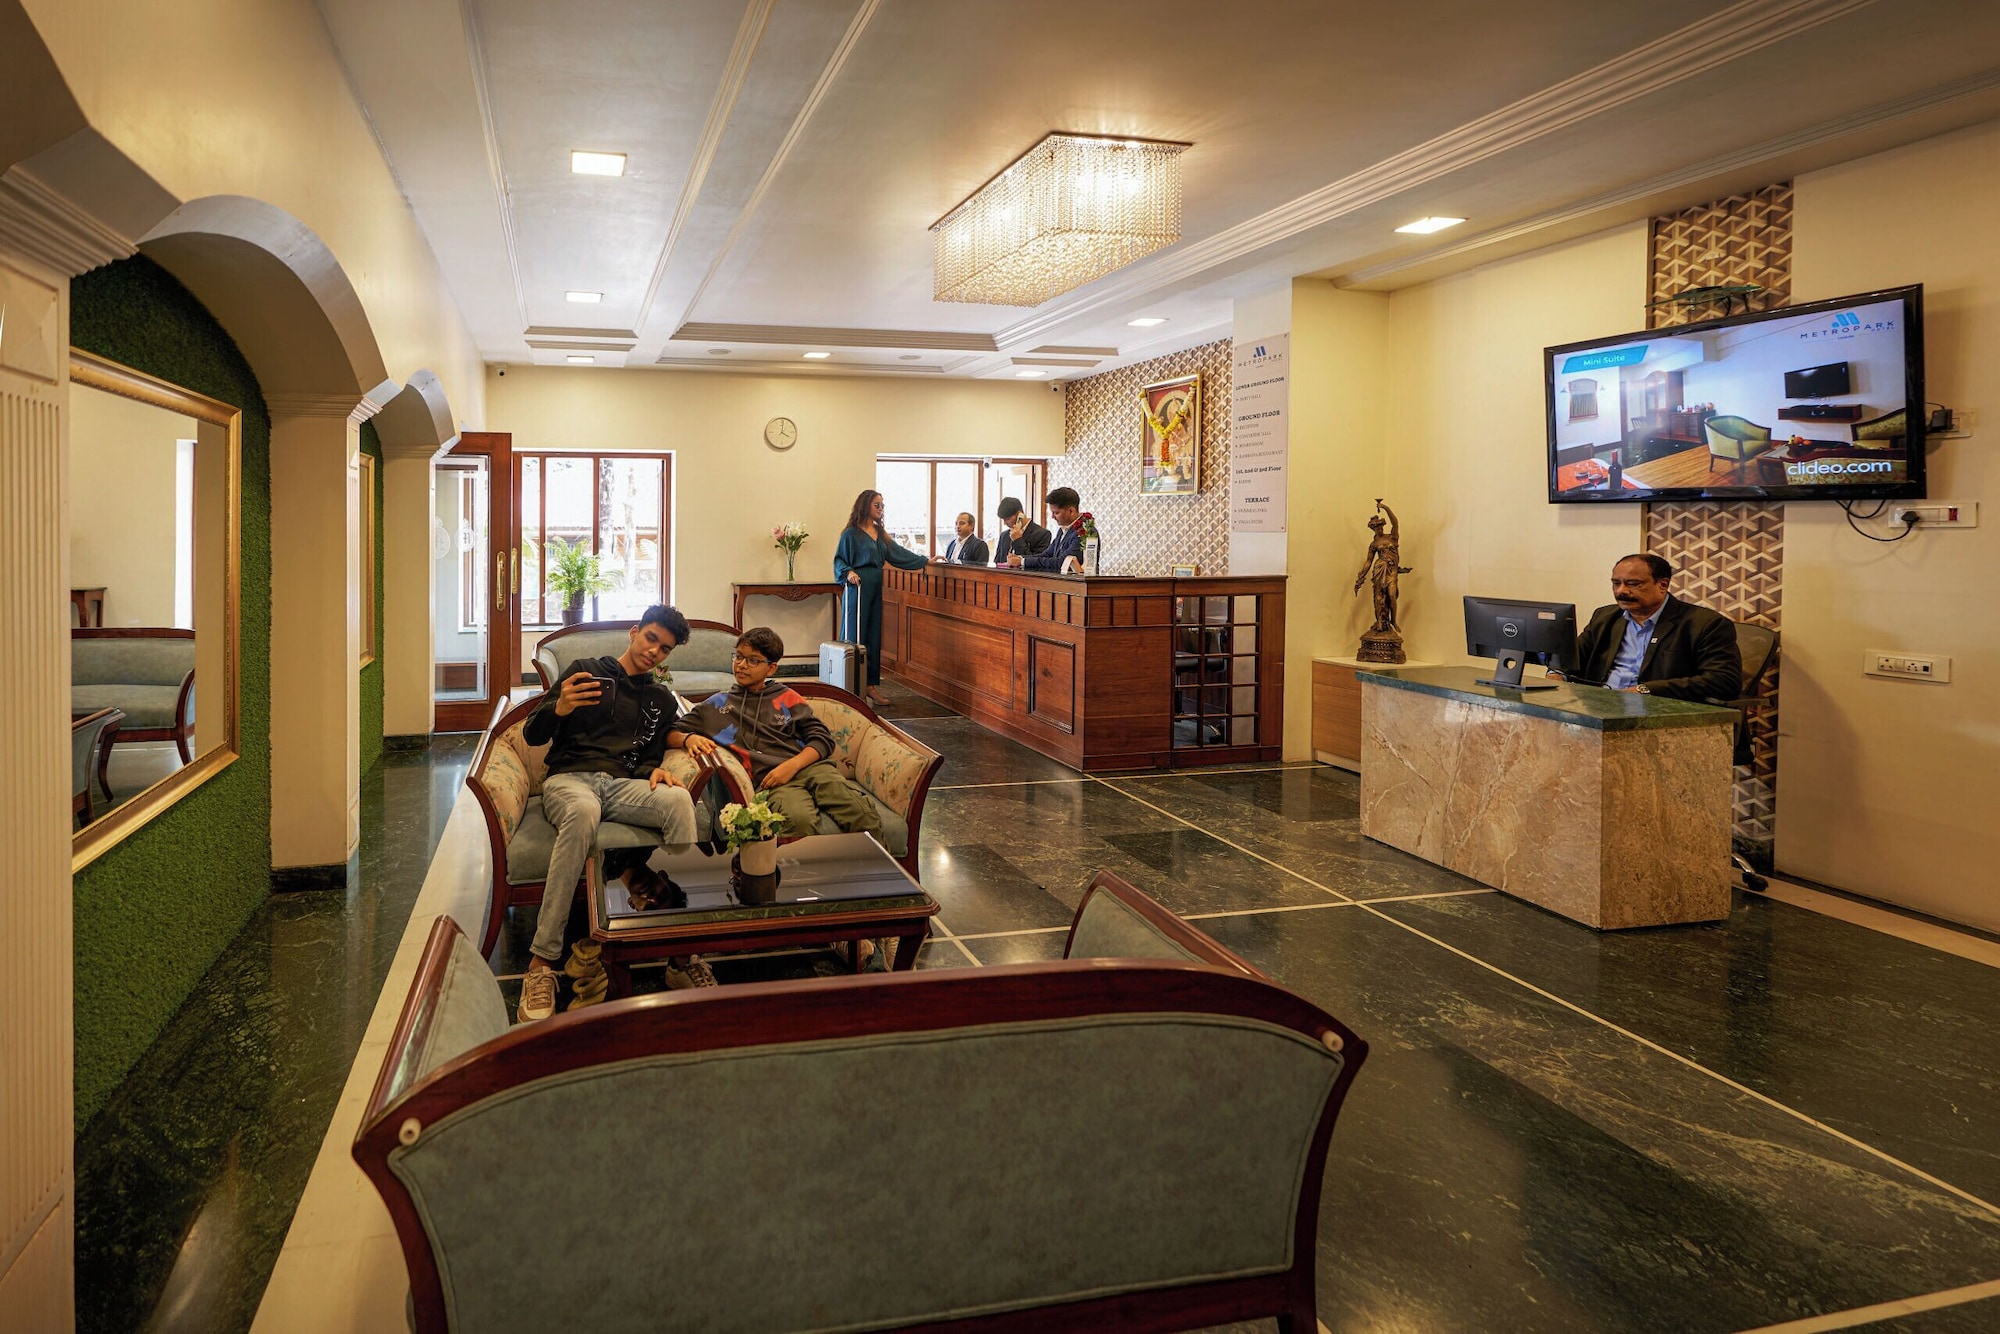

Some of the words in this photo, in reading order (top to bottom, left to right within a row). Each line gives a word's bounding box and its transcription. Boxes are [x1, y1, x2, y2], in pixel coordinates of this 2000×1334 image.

[1800, 320, 1894, 339] METROPARK
[1238, 353, 1283, 367] METROPARK
[1584, 358, 1601, 366] Mini
[1238, 413, 1261, 422] GROUND
[1262, 410, 1280, 418] FLOOR
[1787, 461, 1892, 475] clideo.com
